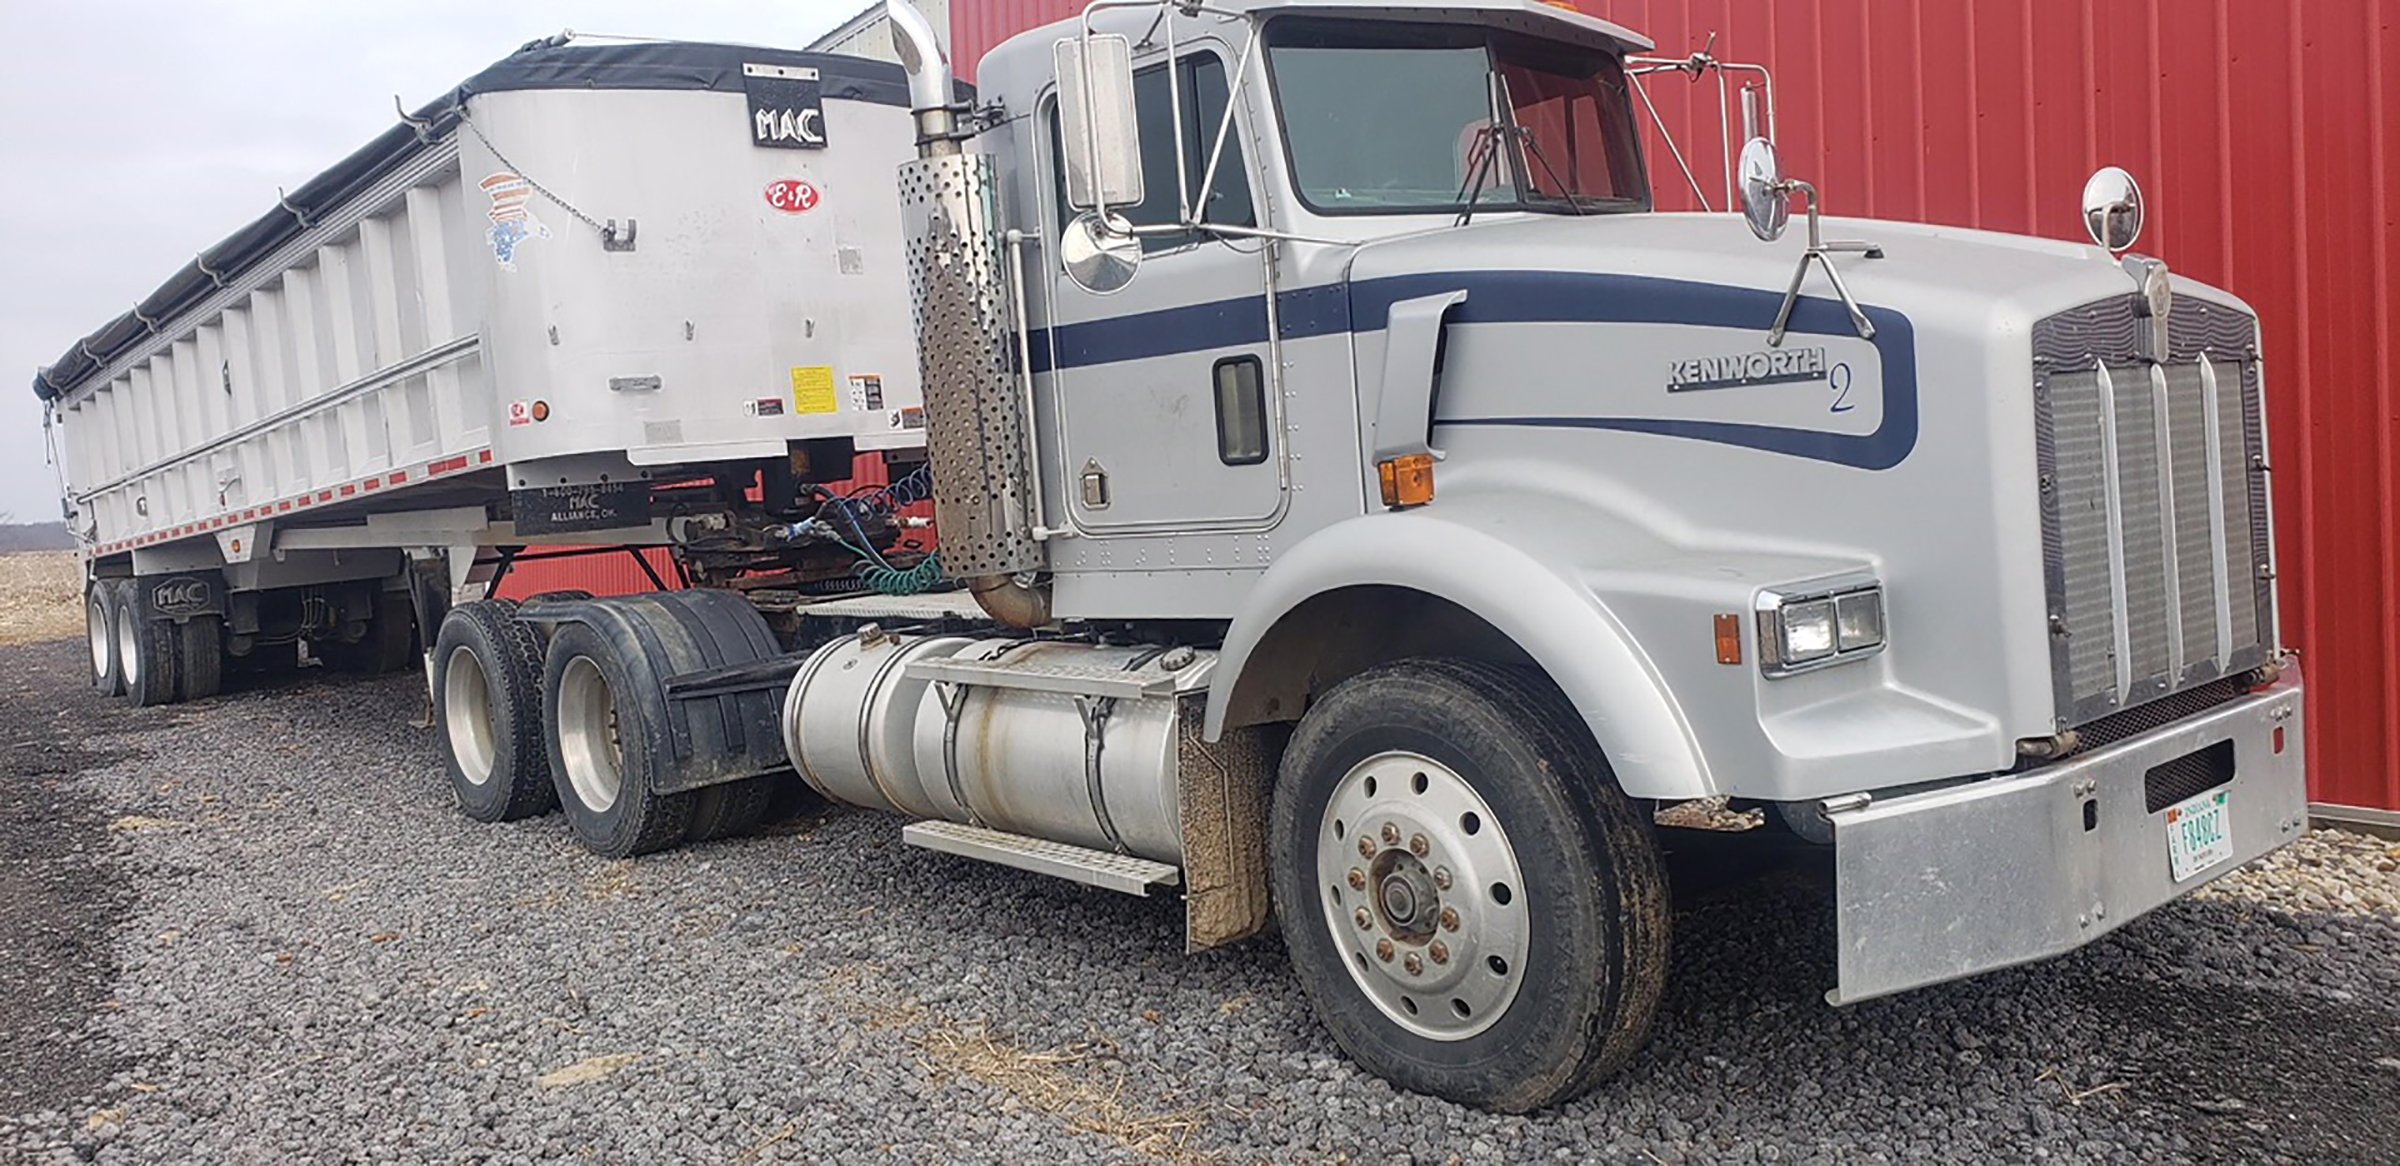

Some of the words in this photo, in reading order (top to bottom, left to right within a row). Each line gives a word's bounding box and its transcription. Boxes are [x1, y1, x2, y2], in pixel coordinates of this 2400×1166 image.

[755, 108, 823, 142] MAC
[1668, 347, 1826, 385] KENWORTH
[1829, 362, 1855, 413] 2
[569, 494, 600, 510] MAC
[158, 583, 204, 605] MAC
